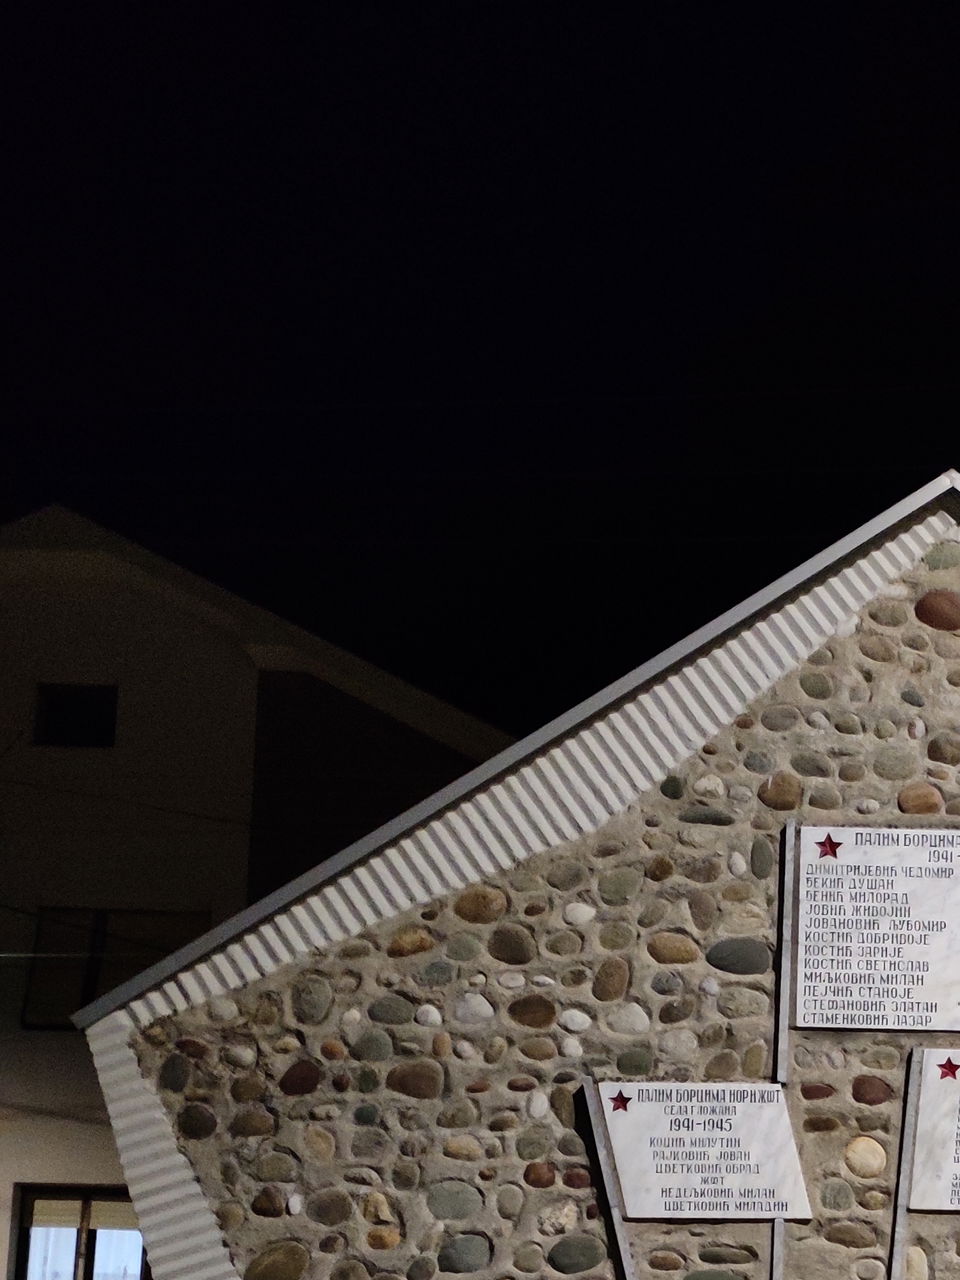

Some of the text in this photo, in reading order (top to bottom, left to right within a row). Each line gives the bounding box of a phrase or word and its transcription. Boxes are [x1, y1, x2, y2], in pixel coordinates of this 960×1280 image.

[855, 833, 899, 846] ПАЛИМ
[902, 867, 953, 878] ЧЕДОМИР
[849, 879, 894, 890] ДУШАН
[850, 892, 909, 904] МИЛОРАД
[806, 905, 846, 916] ЈОВИЋ
[805, 918, 879, 930] ЈОВАНОВИЋ
[804, 932, 930, 945] КОСТИЋ ДОБРИВОЈЕ
[804, 945, 852, 957] КОСТИЋ
[804, 959, 929, 972] КОСТИЋ СВЕТИСЛАВ
[880, 974, 924, 985] МИЛАН
[859, 987, 914, 999] СТАНОЈЕ
[893, 1015, 932, 1026] ЛАЗАР
[676, 1090, 726, 1103] БОРЦИМА
